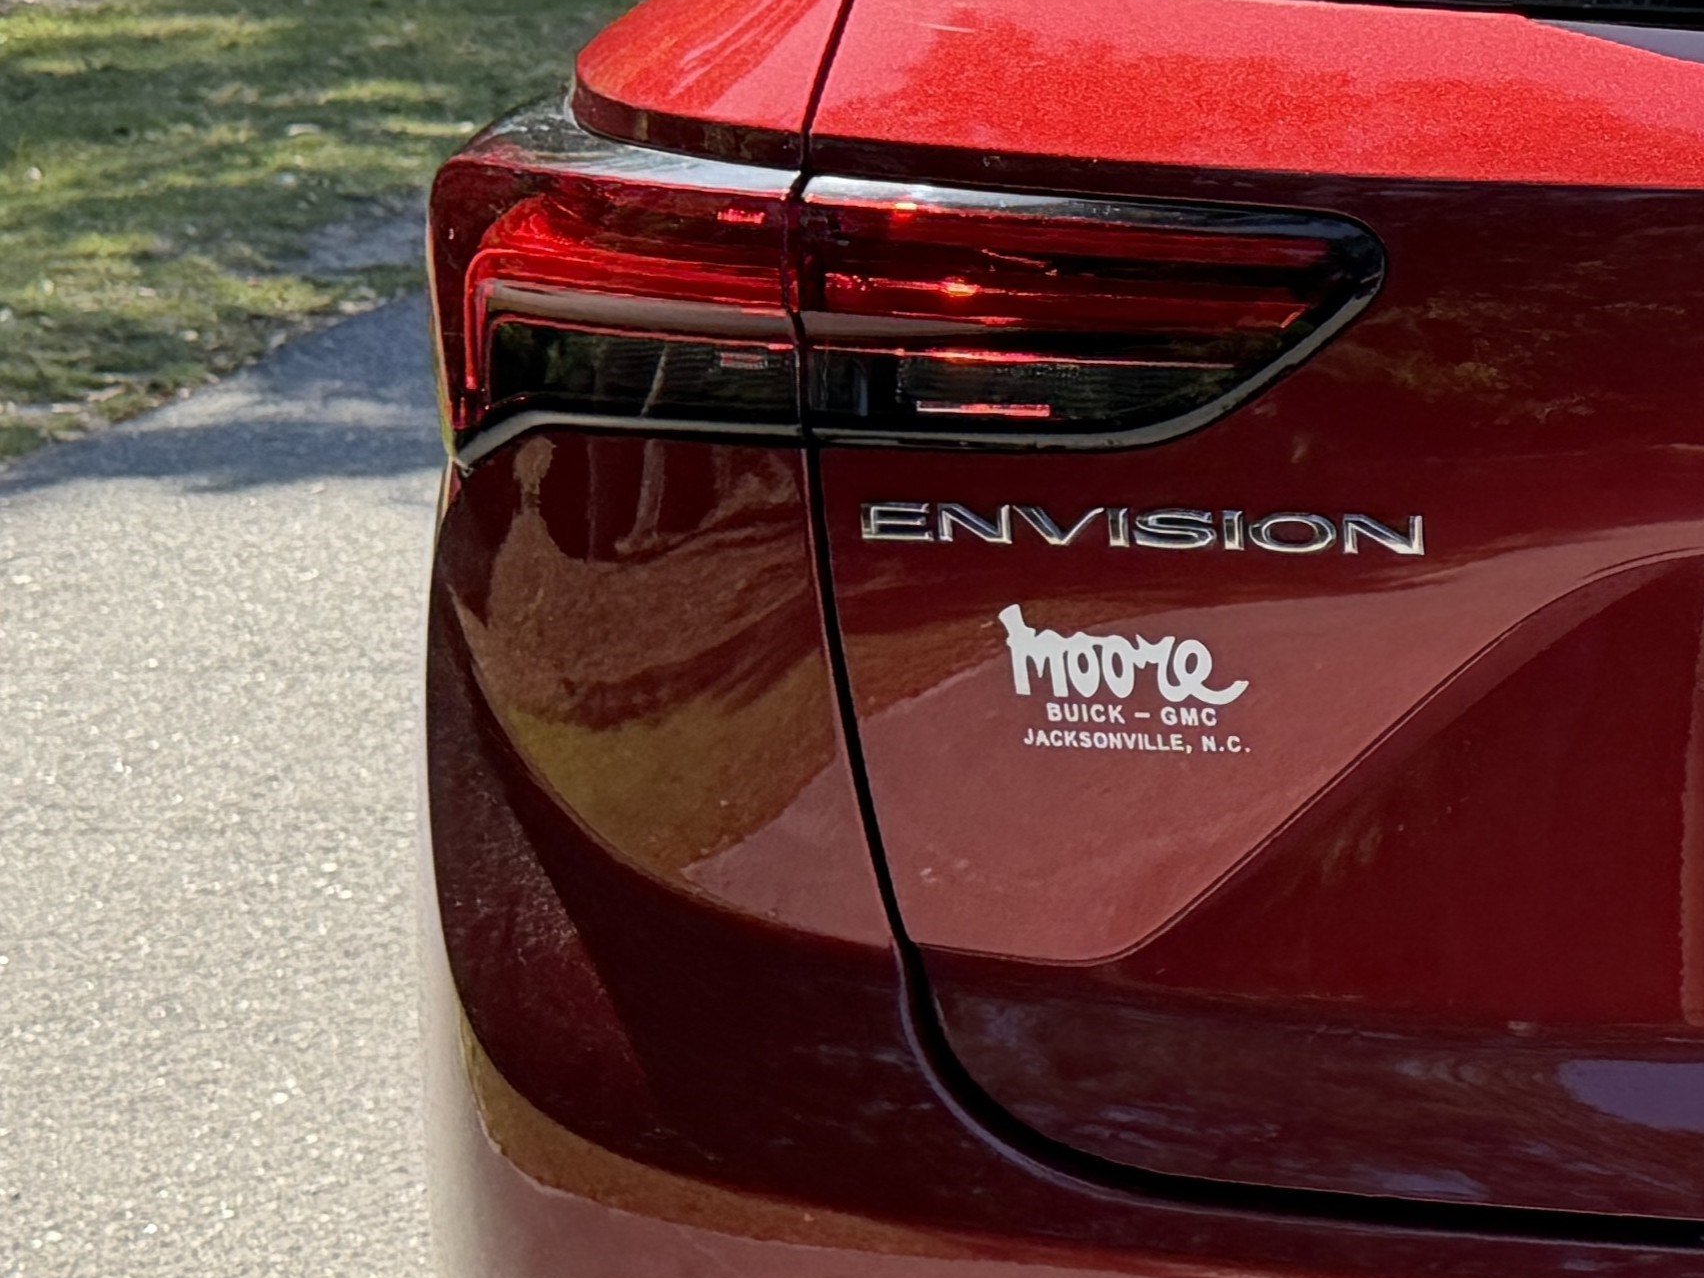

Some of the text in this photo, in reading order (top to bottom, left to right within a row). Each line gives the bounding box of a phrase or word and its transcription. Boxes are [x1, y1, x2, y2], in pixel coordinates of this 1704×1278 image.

[860, 502, 1425, 556] ENVISION
[1046, 703, 1126, 724] BUICK
[1160, 706, 1217, 727] GMC
[1024, 728, 1251, 754] JACKSONVILLE, N.C.
